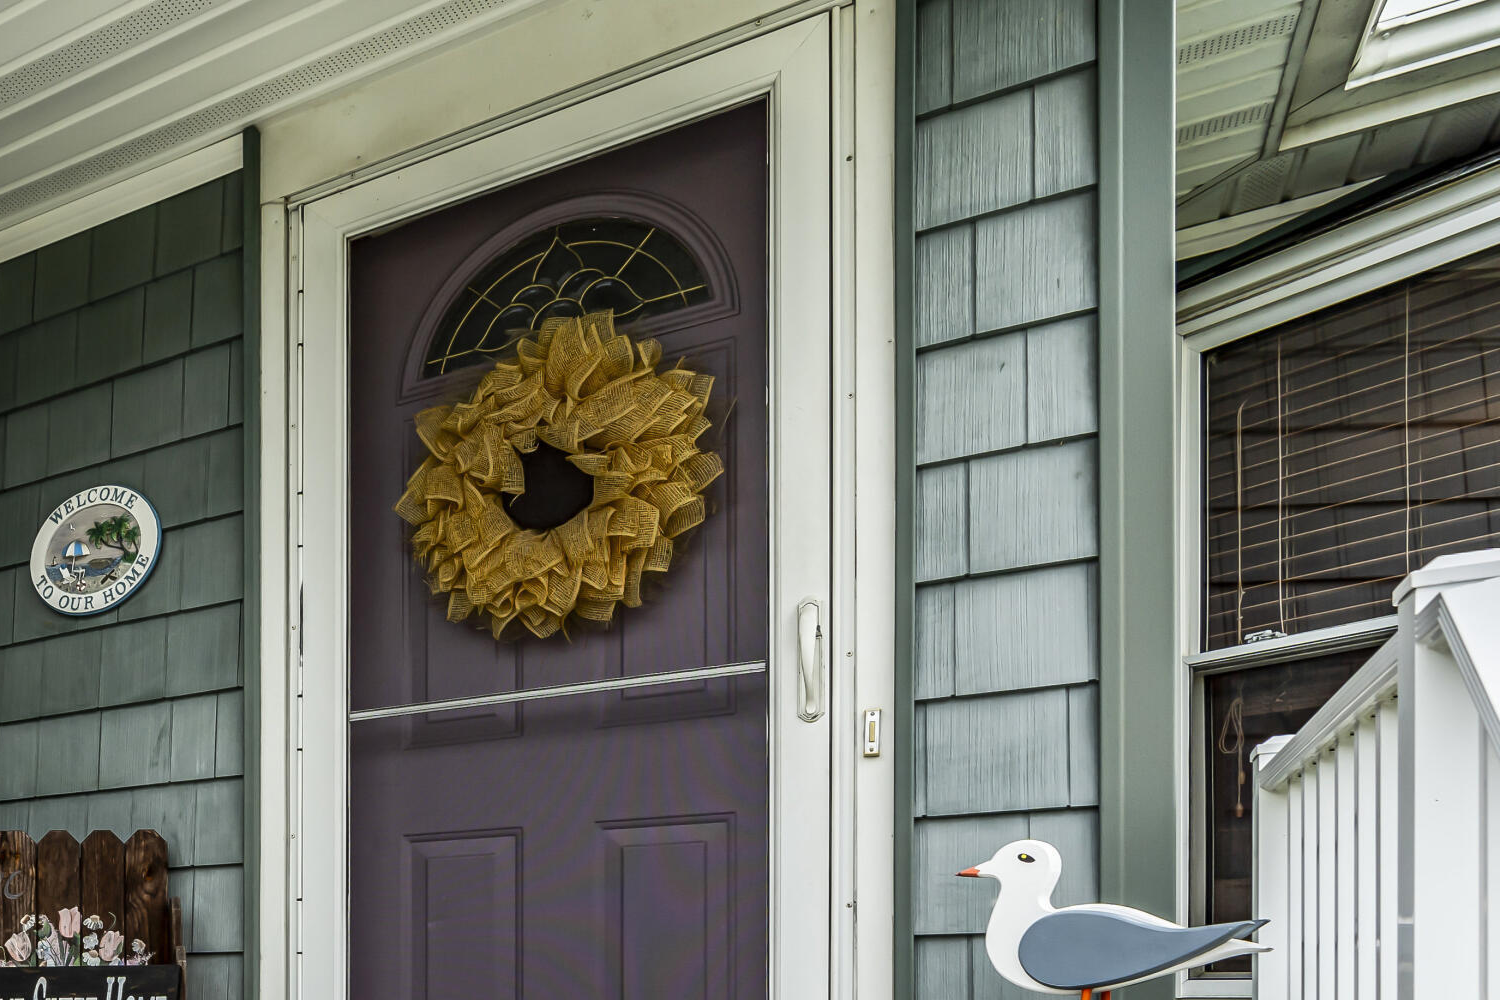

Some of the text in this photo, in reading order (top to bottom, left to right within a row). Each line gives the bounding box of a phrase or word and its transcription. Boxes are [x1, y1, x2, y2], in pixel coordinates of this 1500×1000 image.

[49, 487, 138, 525] WELCOME
[36, 554, 150, 611] TO OUR HOME
